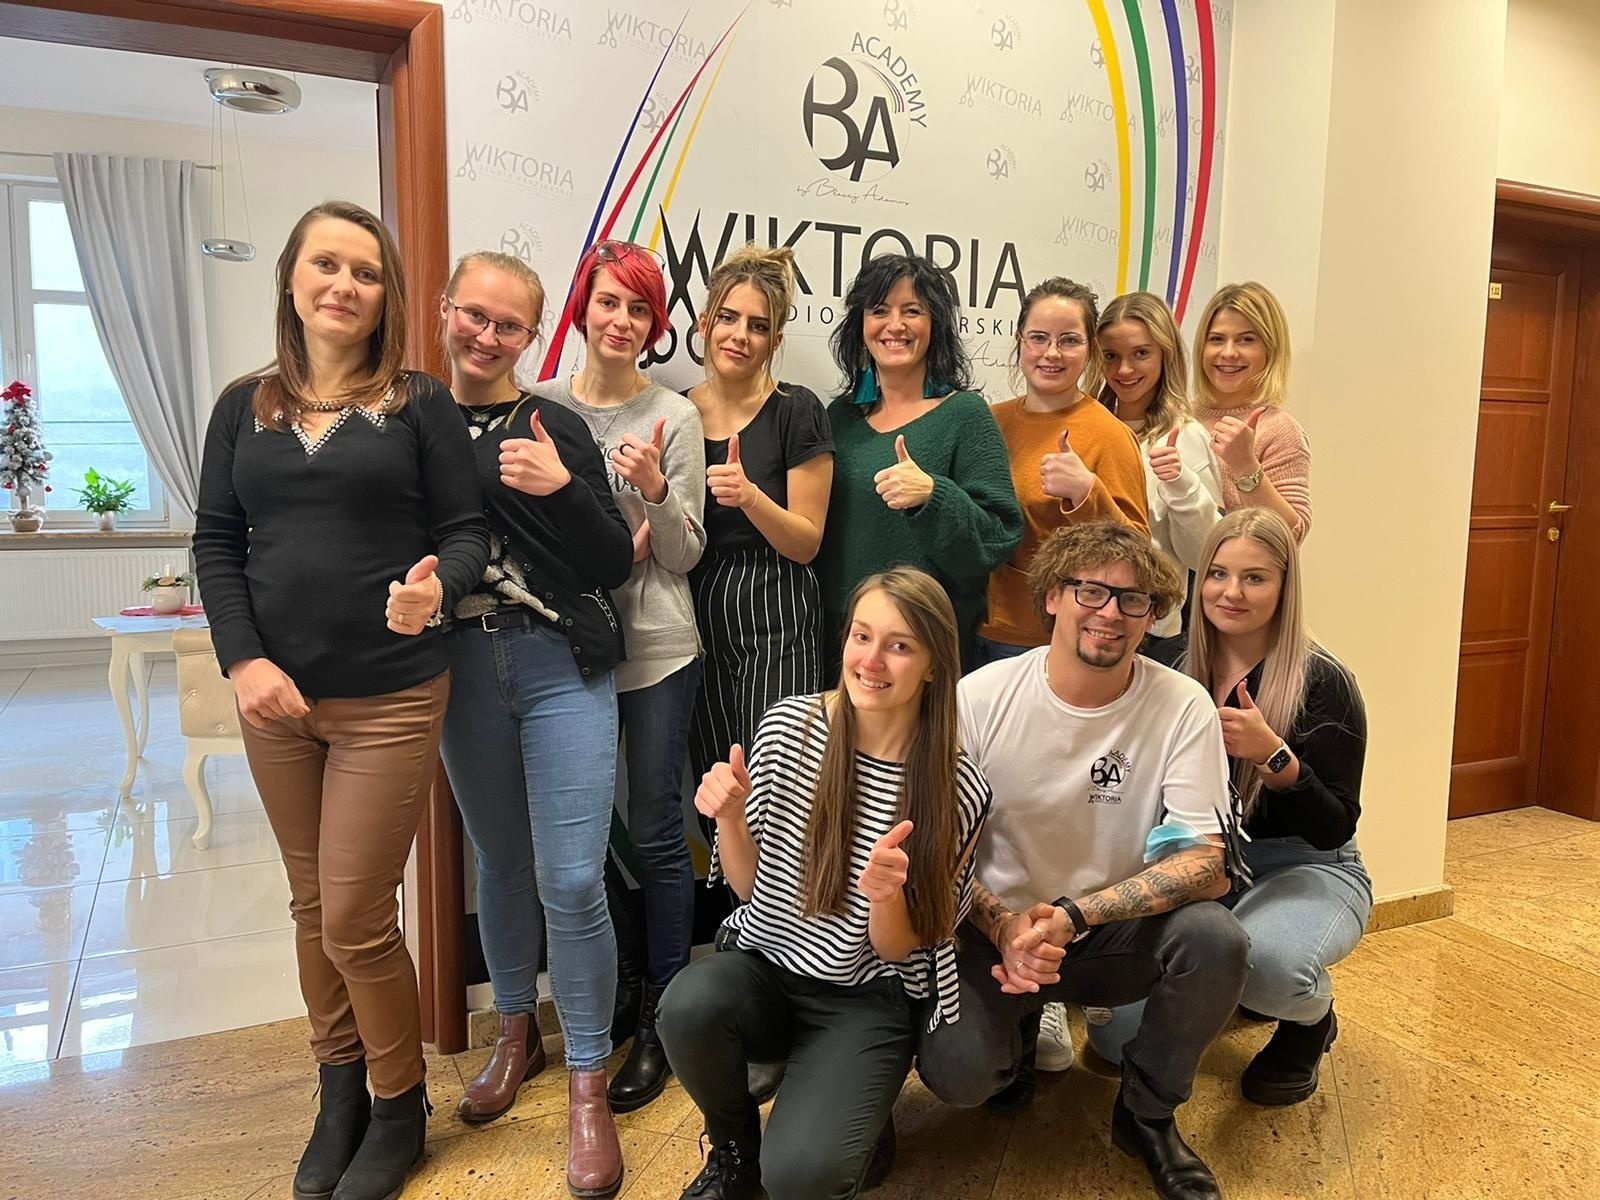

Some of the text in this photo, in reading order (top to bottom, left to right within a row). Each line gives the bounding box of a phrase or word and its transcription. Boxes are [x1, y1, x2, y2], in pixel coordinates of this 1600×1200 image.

[462, 0, 571, 40] KTORIA
[606, 8, 707, 60] WIKTORIA
[851, 32, 928, 128] ACADEMY
[967, 72, 1042, 117] WIKTORIA
[1067, 90, 1136, 132] WIKTOA
[465, 137, 574, 191] WIKTORIA
[1062, 212, 1121, 248] WIKTORI
